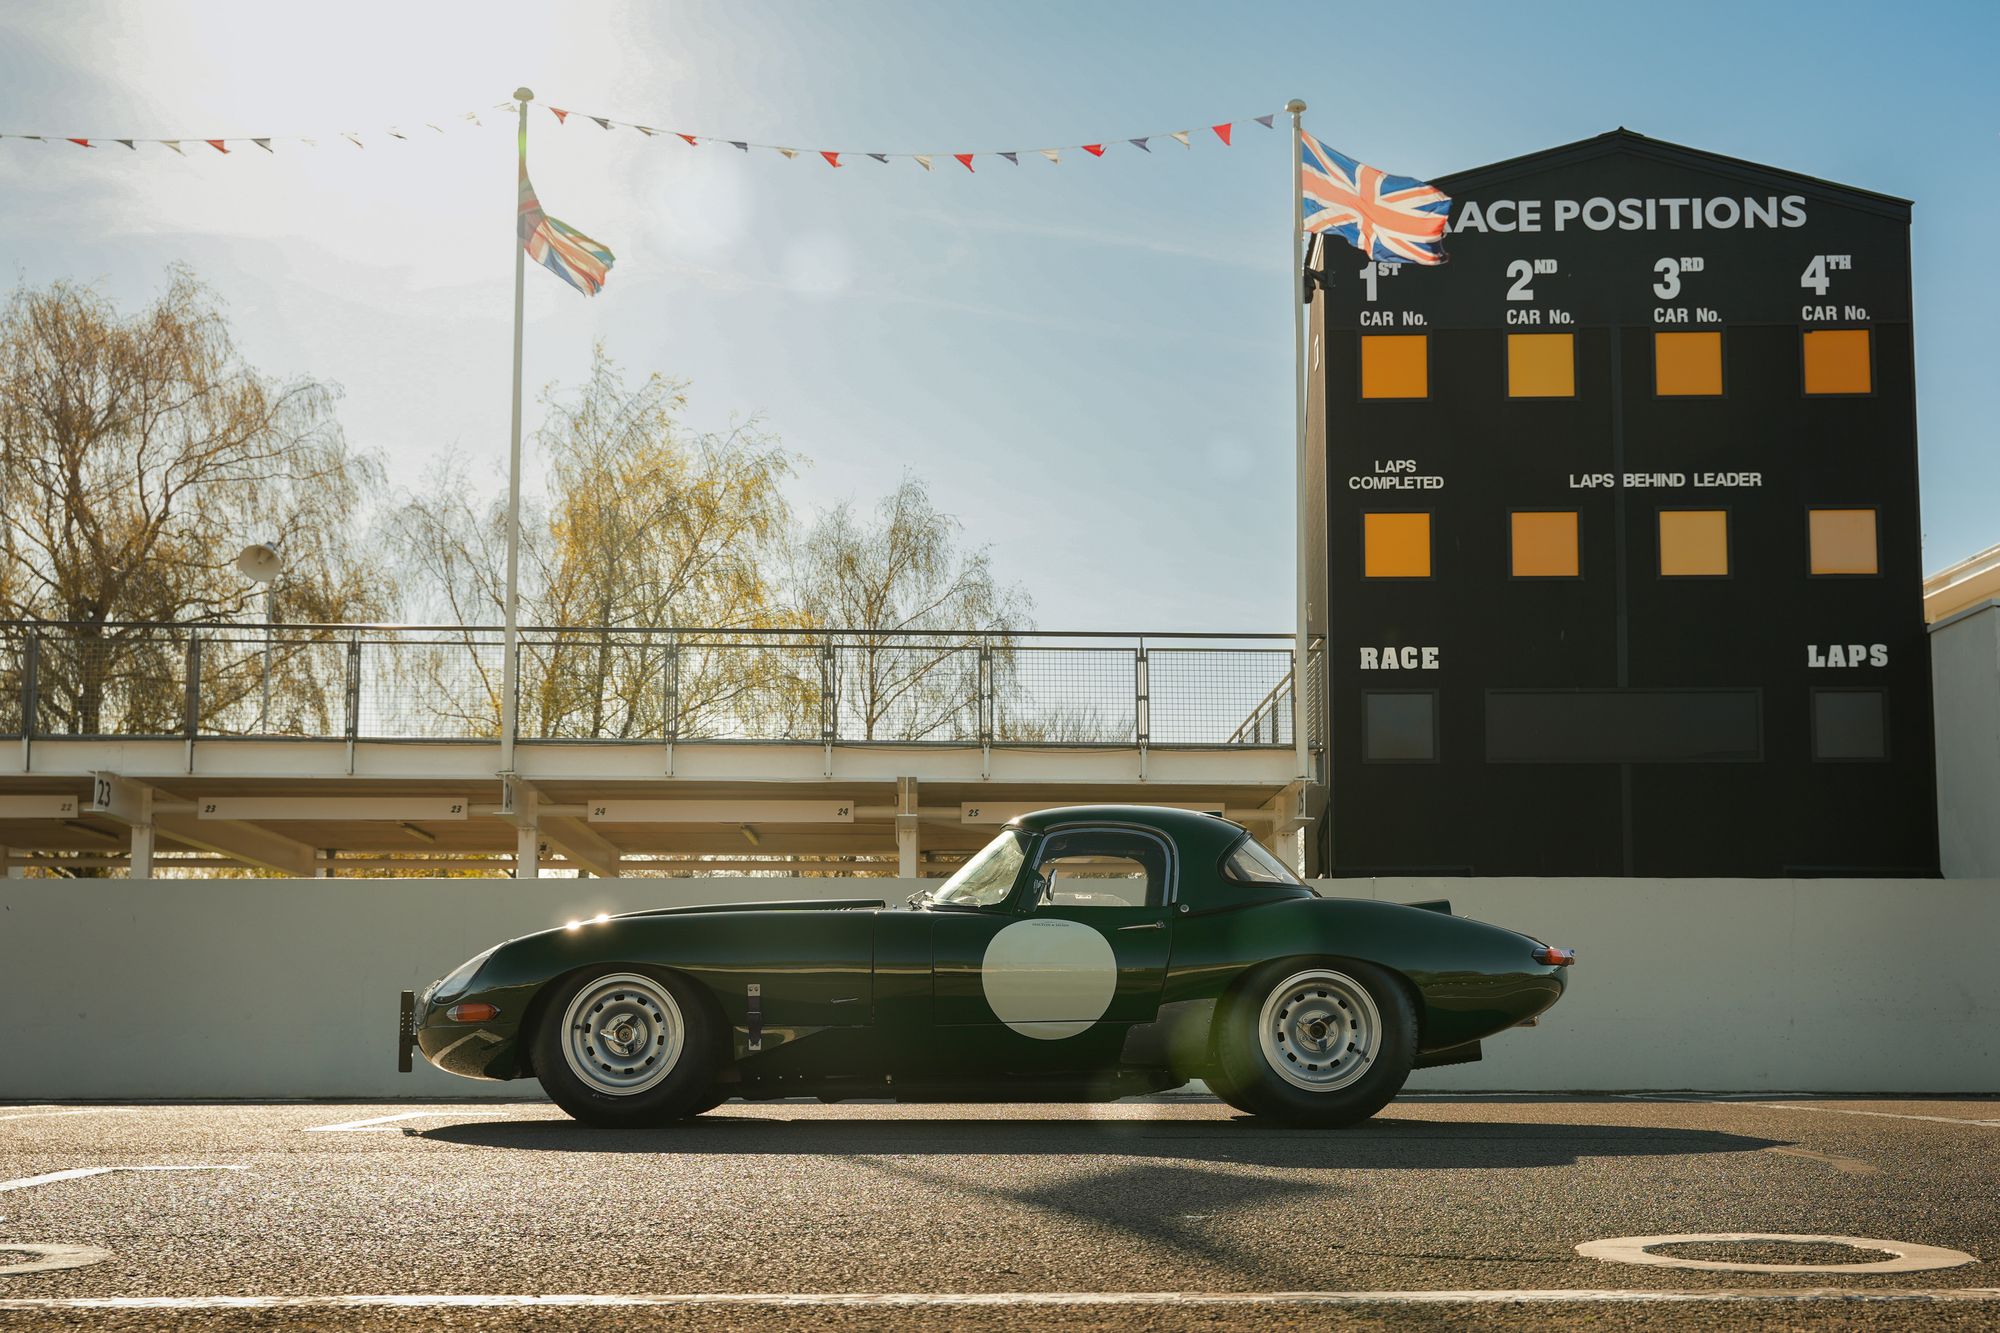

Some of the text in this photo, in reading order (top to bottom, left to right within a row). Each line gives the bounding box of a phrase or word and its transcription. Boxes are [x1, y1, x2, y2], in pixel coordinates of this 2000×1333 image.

[1444, 195, 1807, 234] ACE POSITIONS
[1506, 258, 1558, 301] 2ND
[1652, 256, 1705, 300] 3RD
[1800, 254, 1852, 296] 4TH
[1360, 310, 1428, 326] CAR No.
[1506, 309, 1575, 325] CAR No.
[1653, 307, 1722, 323] CAR No.
[1801, 305, 1871, 321] CAR No.
[1374, 459, 1417, 474] LAPS
[1348, 476, 1445, 490] COMPLETED
[1569, 472, 1763, 489] LAPS BEHIND LEADER
[1360, 646, 1440, 670] RACE
[1807, 644, 1889, 668] LAPS
[97, 779, 111, 807] 23
[204, 804, 216, 813] 23
[450, 804, 462, 813] 23
[594, 807, 606, 816] 24
[837, 807, 849, 816] 24
[968, 808, 979, 817] 25
